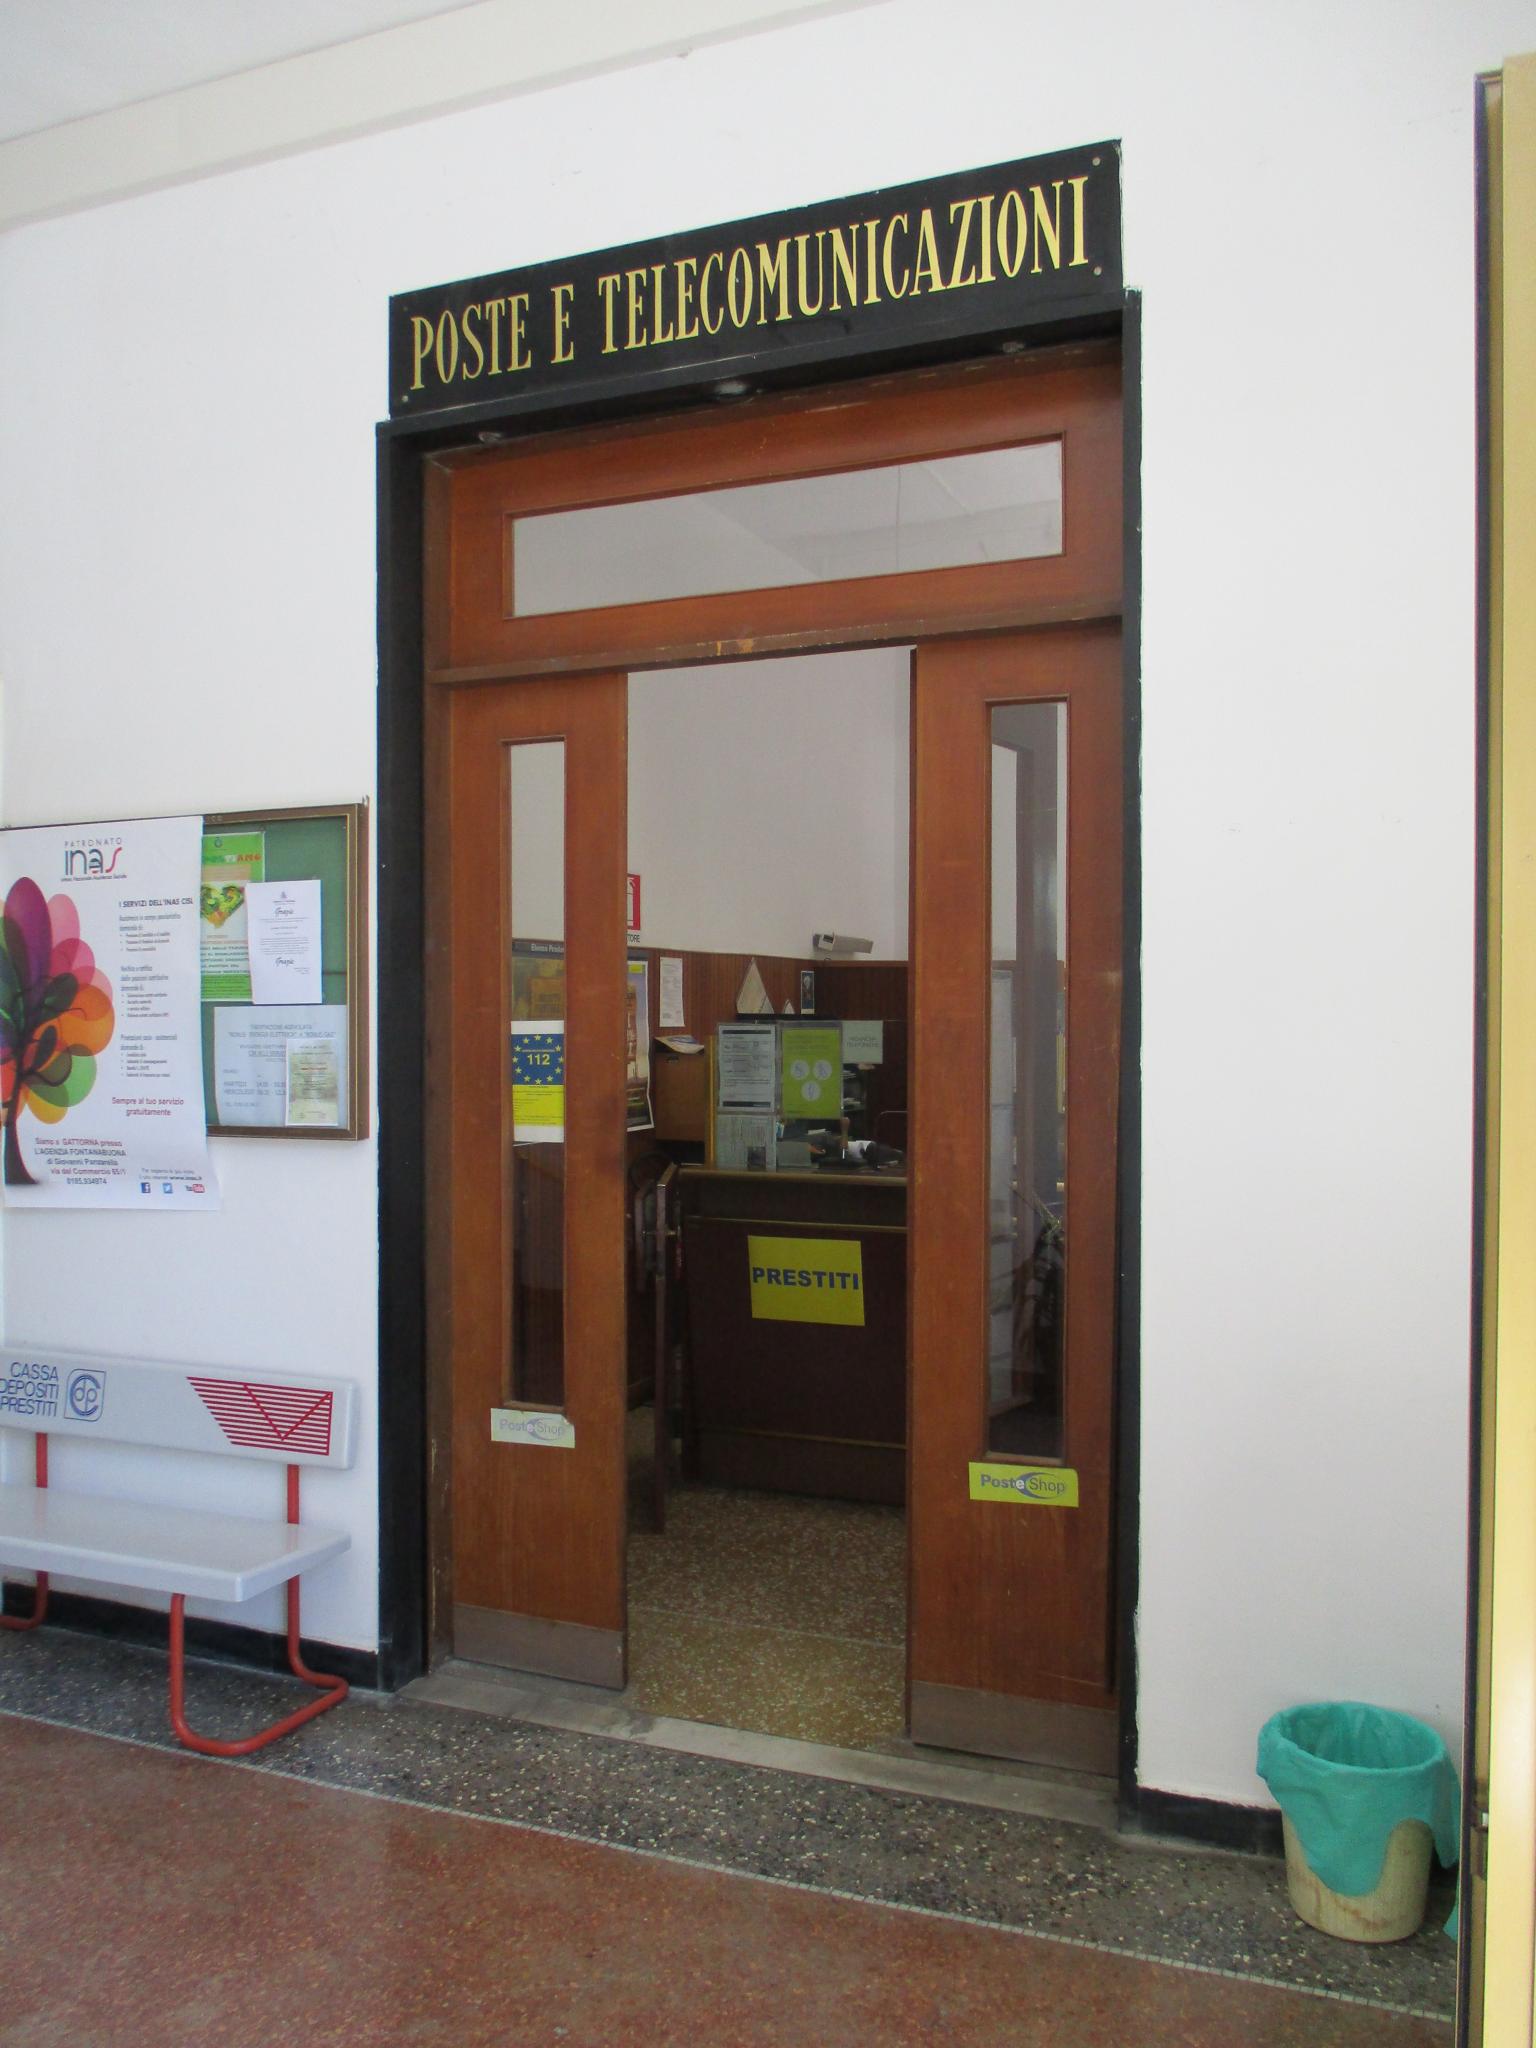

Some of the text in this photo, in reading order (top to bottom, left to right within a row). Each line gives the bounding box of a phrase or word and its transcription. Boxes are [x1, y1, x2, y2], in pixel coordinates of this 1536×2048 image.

[409, 176, 1090, 391] POSTE E TELECOMUNICAZIONI
[64, 837, 122, 847] PATRONATO
[122, 900, 147, 908] SERVIZI
[527, 1053, 551, 1065] 112
[112, 1097, 137, 1105] Sempre
[158, 1097, 184, 1105] servizio
[126, 1109, 171, 1117] gratuitamente
[62, 1138, 99, 1146] GATTORNA
[752, 1266, 859, 1290] PRESTITI
[10, 1362, 59, 1381] CASSA
[0, 1378, 59, 1399] DEPOSITI
[0, 1396, 58, 1417] PRESTITI
